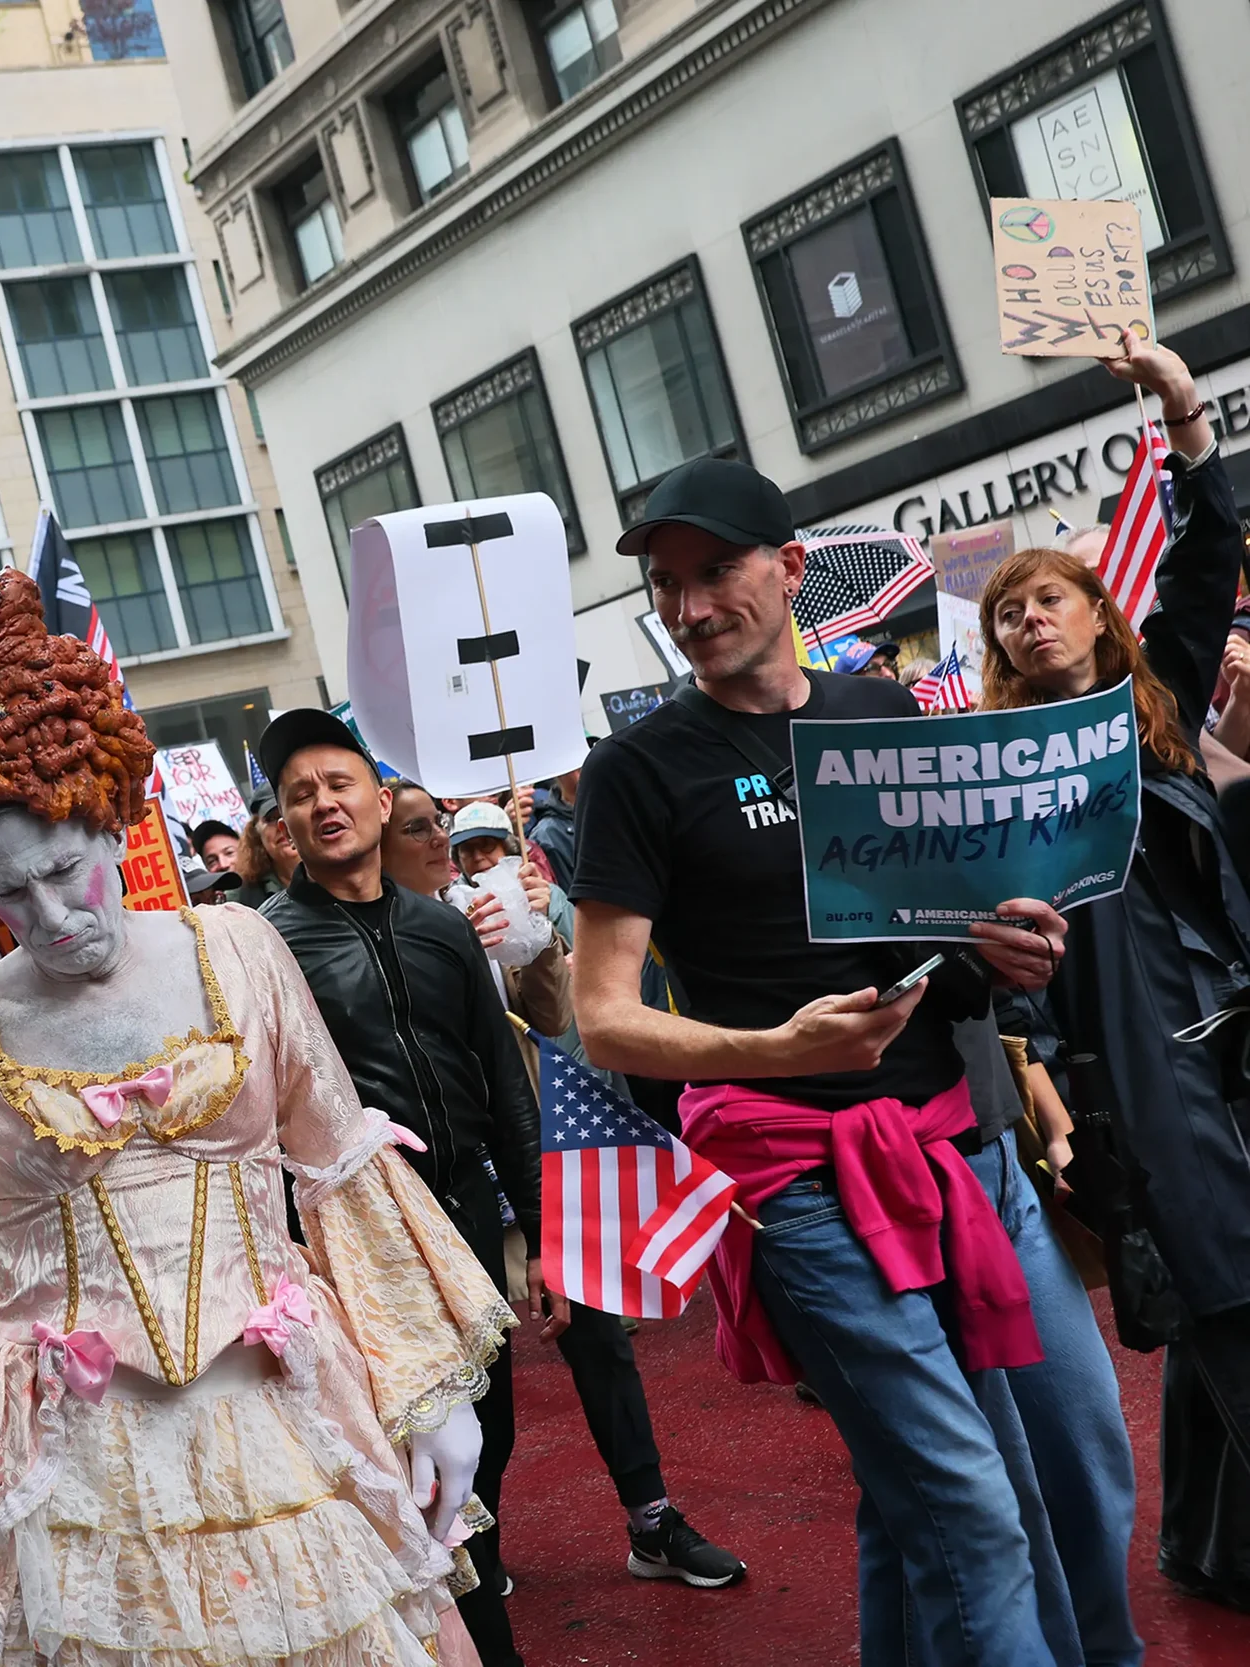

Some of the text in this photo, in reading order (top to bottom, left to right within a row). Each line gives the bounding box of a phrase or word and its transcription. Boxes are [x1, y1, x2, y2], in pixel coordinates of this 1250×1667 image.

[1001, 263, 1048, 349] WHO
[1032, 246, 1090, 348] WOULD
[893, 447, 1088, 546] GALLERY
[815, 713, 1130, 785] AMERICANS
[733, 773, 772, 802] PR
[740, 799, 797, 830] TRA
[878, 774, 1089, 828] UNITED
[817, 770, 1132, 874] AGAINST KINGS
[120, 850, 170, 896] ICE
[825, 910, 874, 924] au.org
[915, 909, 997, 921] AMERICANS
